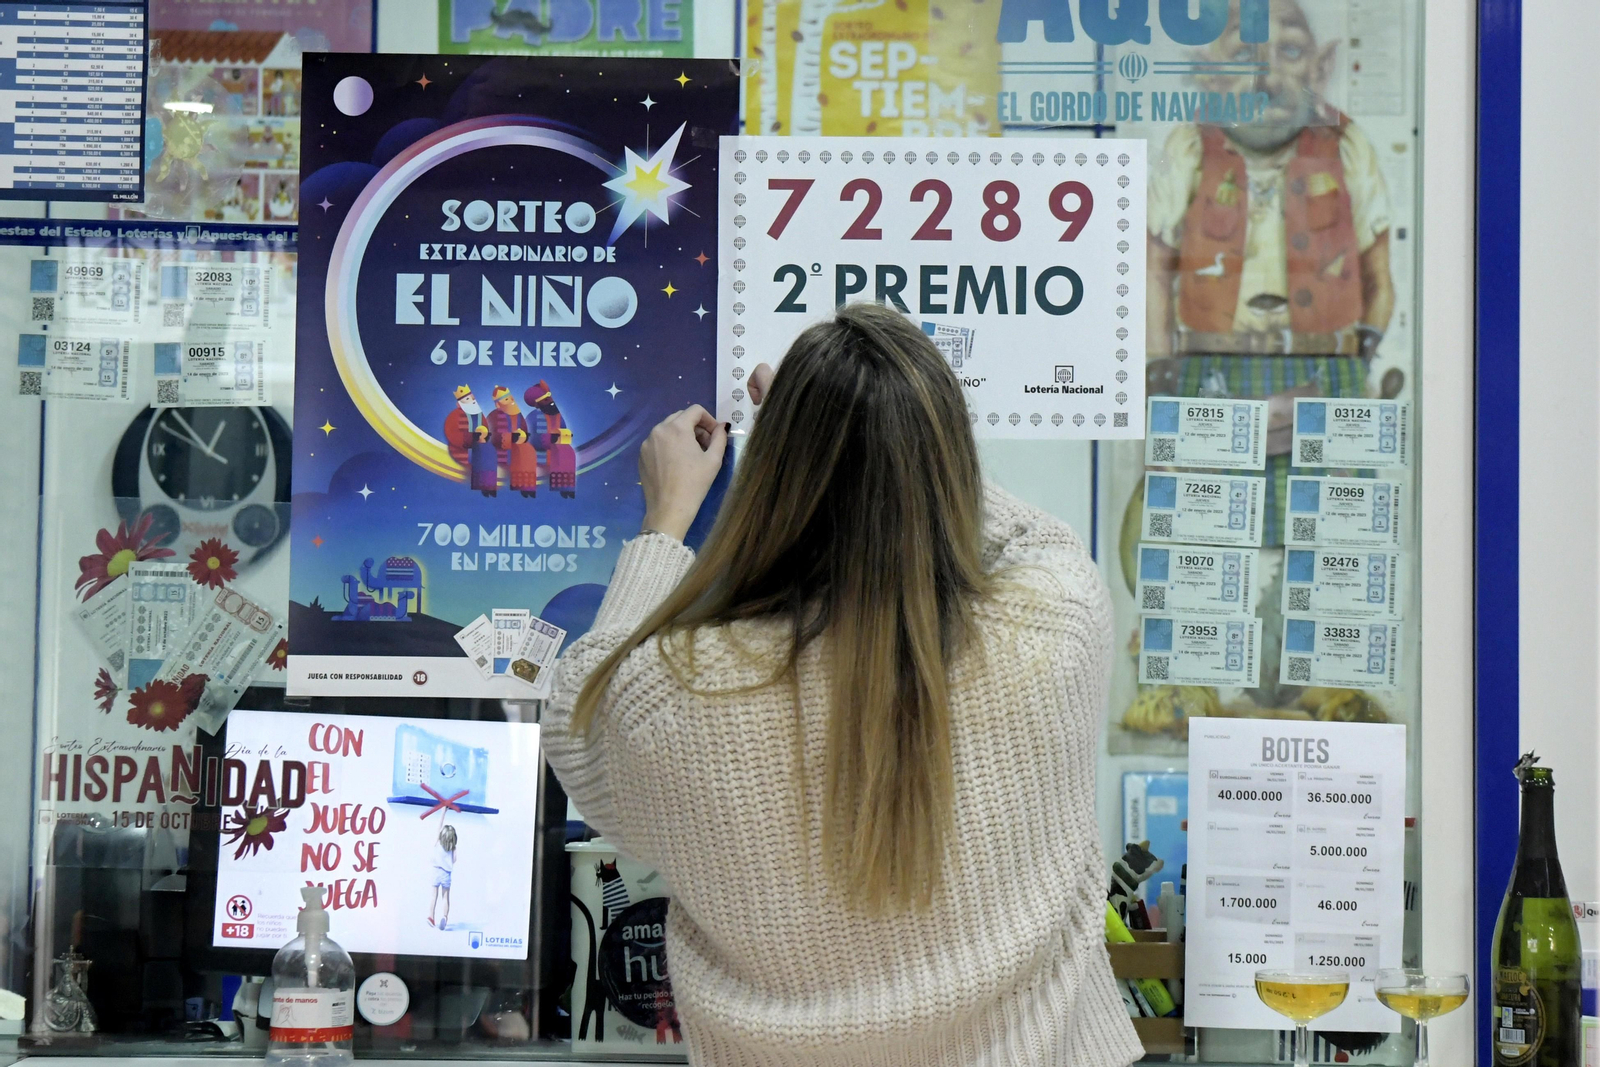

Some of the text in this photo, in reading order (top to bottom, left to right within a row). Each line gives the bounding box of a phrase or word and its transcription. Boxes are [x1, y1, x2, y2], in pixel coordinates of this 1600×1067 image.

[829, 41, 938, 80] SEP-
[997, 91, 1022, 122] EL
[1031, 91, 1107, 122] GORDO
[1115, 91, 1143, 122] DE
[441, 199, 597, 234] SORTEO
[39, 226, 60, 237] del
[65, 227, 111, 238] Estado
[118, 228, 173, 239] Loterías
[177, 230, 185, 241] y
[201, 231, 265, 242] Apuestas
[269, 231, 288, 242] del
[420, 244, 616, 263] EXTRAORDINARIO DE
[66, 266, 103, 277] 49969
[195, 272, 232, 283] 32083
[835, 265, 1084, 316] PREMIO
[396, 273, 638, 328] EL NIÑO
[54, 340, 91, 352] 03124
[189, 347, 225, 357] 00915
[430, 340, 601, 368] 6 DE ENERO
[958, 376, 986, 387] IÑO"
[1024, 384, 1104, 395] Lotería Nacional
[1187, 407, 1224, 418] 67815
[1335, 408, 1371, 418] 03124
[1185, 483, 1221, 494] 72462
[1328, 487, 1364, 497] 70969
[417, 523, 606, 549] 700 MILLONES
[451, 552, 577, 572] EN PREMIOS
[1178, 555, 1214, 566] 19070
[1323, 557, 1359, 567] 92476
[1181, 625, 1217, 636] 73953
[1324, 627, 1360, 638] 33833
[307, 673, 403, 681] JUEGA CON RESPONSABILIDAD
[308, 722, 363, 757] CON
[1262, 737, 1330, 763] BOTES
[306, 761, 334, 794] EL
[1218, 790, 1283, 801] 40.000.000
[1307, 793, 1372, 804] 36.500.000
[112, 811, 130, 827] 15
[135, 812, 155, 828] DE
[303, 802, 386, 835] JUEGO
[300, 842, 379, 872] NO SE
[1310, 846, 1367, 857] 5.000.000
[298, 878, 377, 911] UEGA
[1220, 897, 1277, 908] 1.700.000
[1318, 900, 1357, 911] 46.000
[226, 925, 249, 937] +18
[622, 923, 666, 940] ama
[1228, 953, 1267, 964] 15.000
[1308, 956, 1365, 967] 1.250.000
[619, 993, 632, 1001] Haz
[644, 990, 668, 1001] pedido
